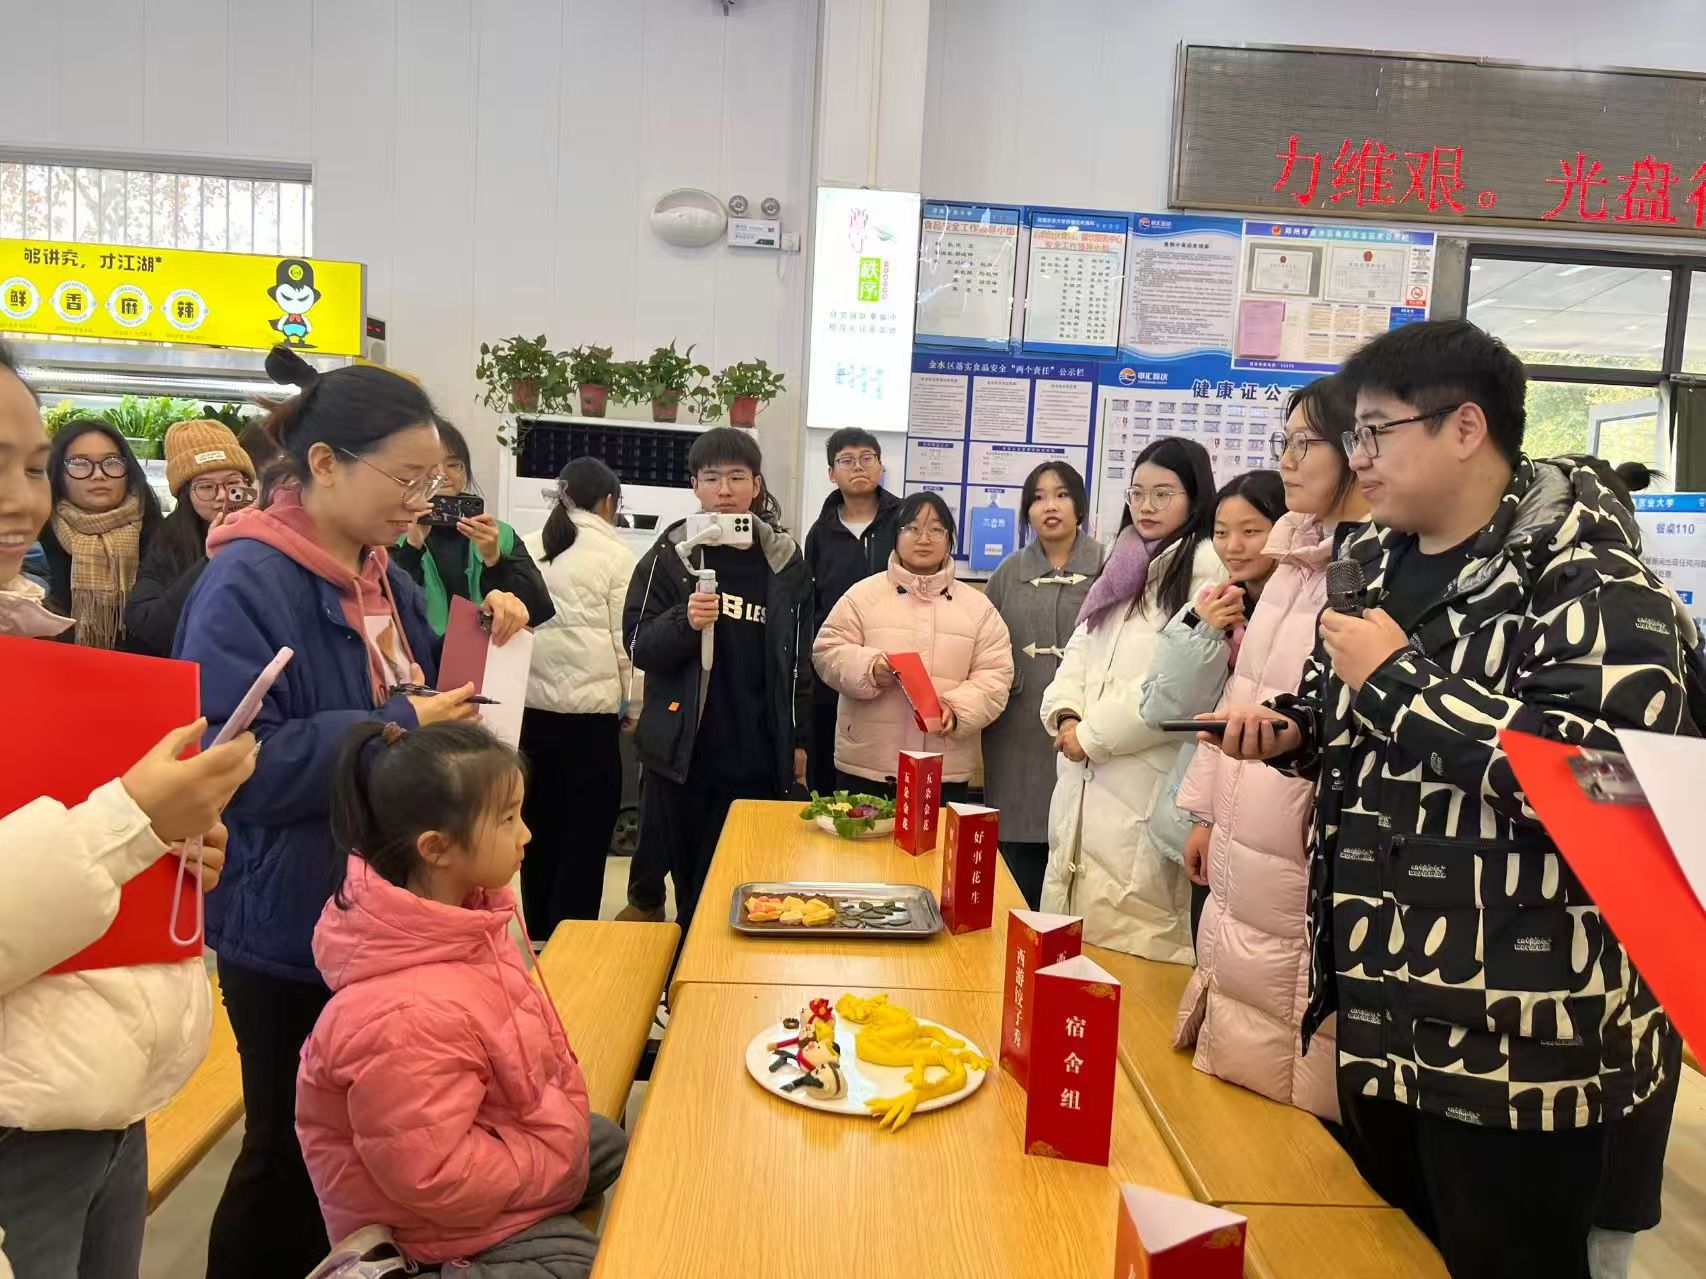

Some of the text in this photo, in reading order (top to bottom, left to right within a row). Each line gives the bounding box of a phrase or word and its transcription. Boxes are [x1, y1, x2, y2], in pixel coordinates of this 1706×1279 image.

[10, 289, 194, 319] 鲜 香 麻 辣
[1656, 523, 1695, 534] 餐桌110
[970, 830, 985, 904] 好事花生
[1059, 1016, 1087, 1110] 宿舍组
